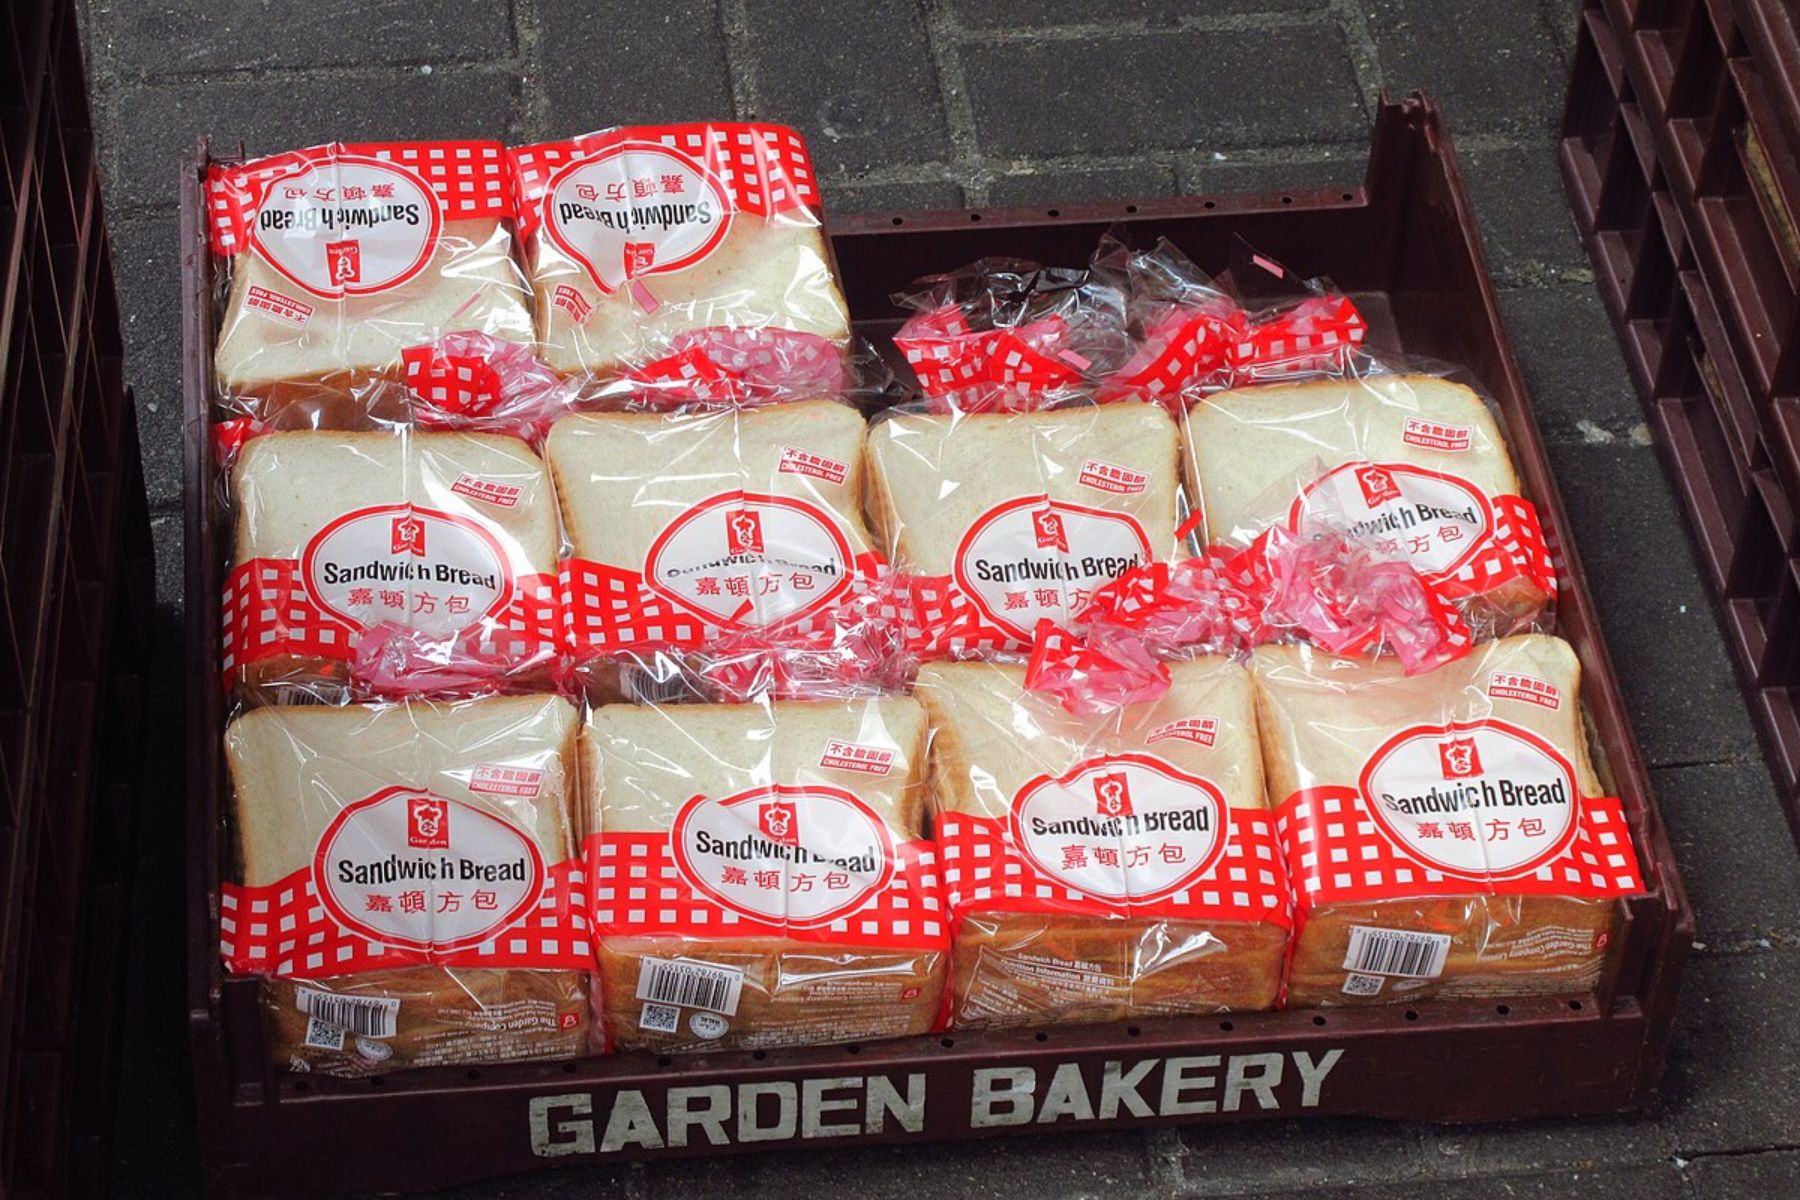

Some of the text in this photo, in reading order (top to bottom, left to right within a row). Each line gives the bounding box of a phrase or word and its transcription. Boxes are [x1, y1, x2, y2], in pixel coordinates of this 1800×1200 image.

[283, 183, 395, 202] 嘉頓方包
[576, 174, 685, 202] 嘉頓方包
[260, 203, 420, 231] Sandwich Bread
[559, 202, 712, 234] Sandwich Bread
[1450, 439, 1468, 449] FREE
[498, 495, 516, 506] FREE
[1416, 503, 1478, 525] Bread
[324, 560, 496, 590] Sandwich Bread
[975, 557, 1079, 582] Sandwich
[696, 572, 815, 597] 嘉頓方包
[347, 588, 471, 615] 嘉頓方包
[1004, 588, 1096, 611] 嘉頓方
[1539, 696, 1558, 708] FREE
[822, 757, 888, 775] CHOLESTEROL FREE
[1382, 778, 1566, 814] Sandwich Bread
[1032, 806, 1209, 837] Sandwich Bread
[1417, 818, 1546, 841] 嘉頓方包
[696, 830, 876, 874] Sandwich ead
[1061, 842, 1186, 870] 嘉頓方包
[338, 854, 525, 885] Sandwich Bread
[721, 866, 850, 892] 嘉頓方包
[365, 889, 498, 914] 嘉頓方包
[528, 1049, 1345, 1157] GARDEN BAKERY
